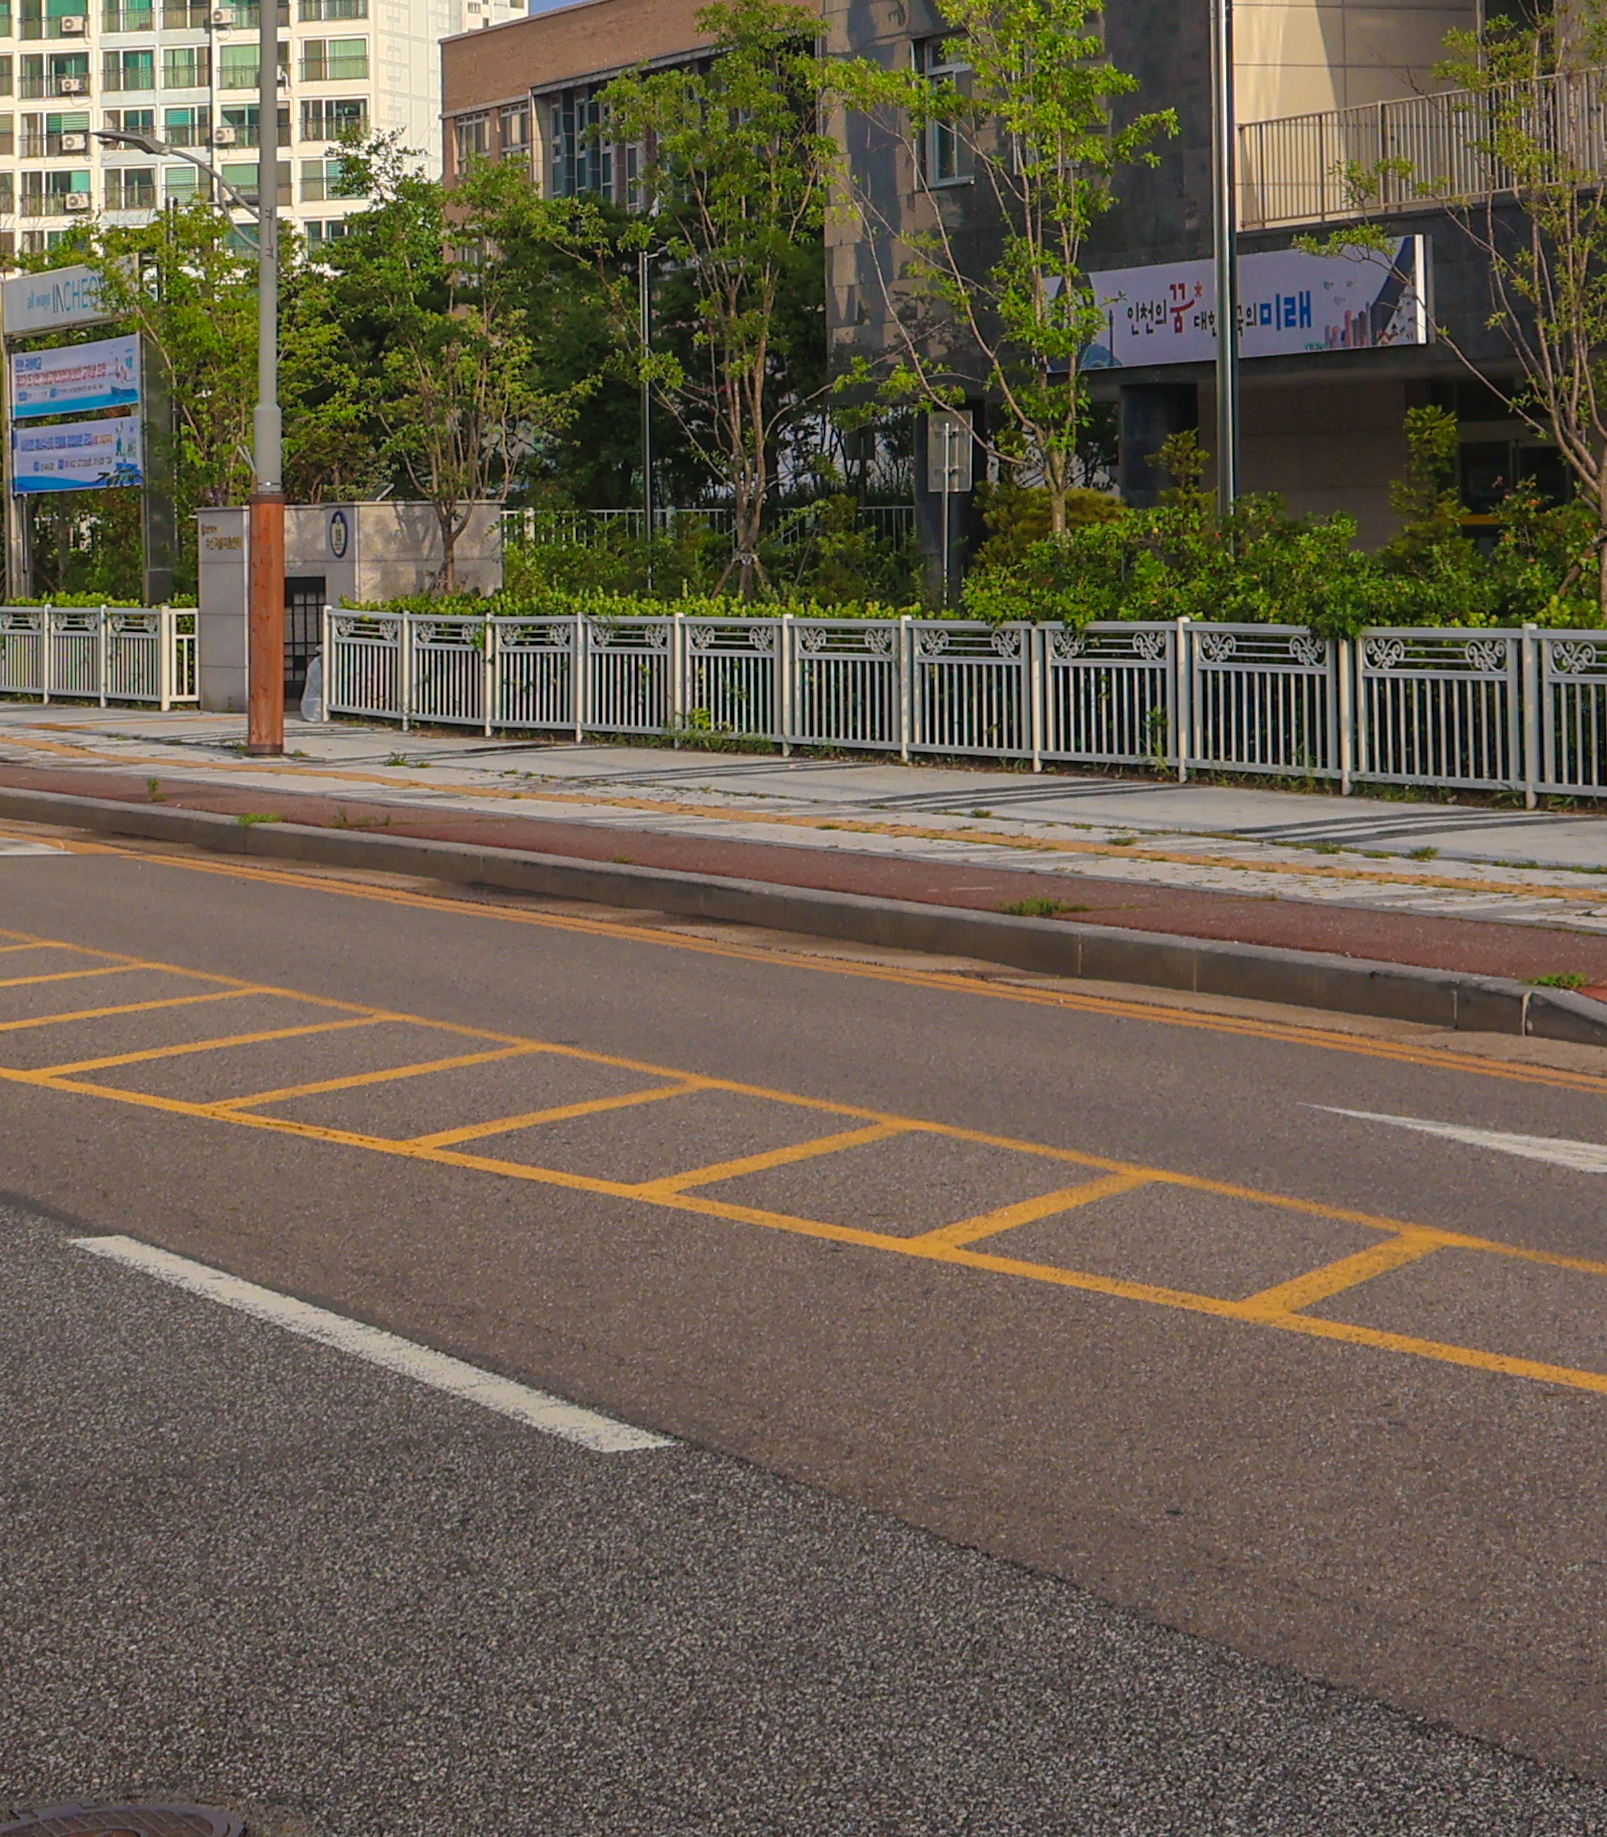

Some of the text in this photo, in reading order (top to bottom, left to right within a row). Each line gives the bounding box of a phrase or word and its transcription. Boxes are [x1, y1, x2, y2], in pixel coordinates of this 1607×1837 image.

[1127, 299, 1167, 336] 인천의
[1169, 282, 1195, 333] 꿈
[1259, 290, 1311, 332] 미래
